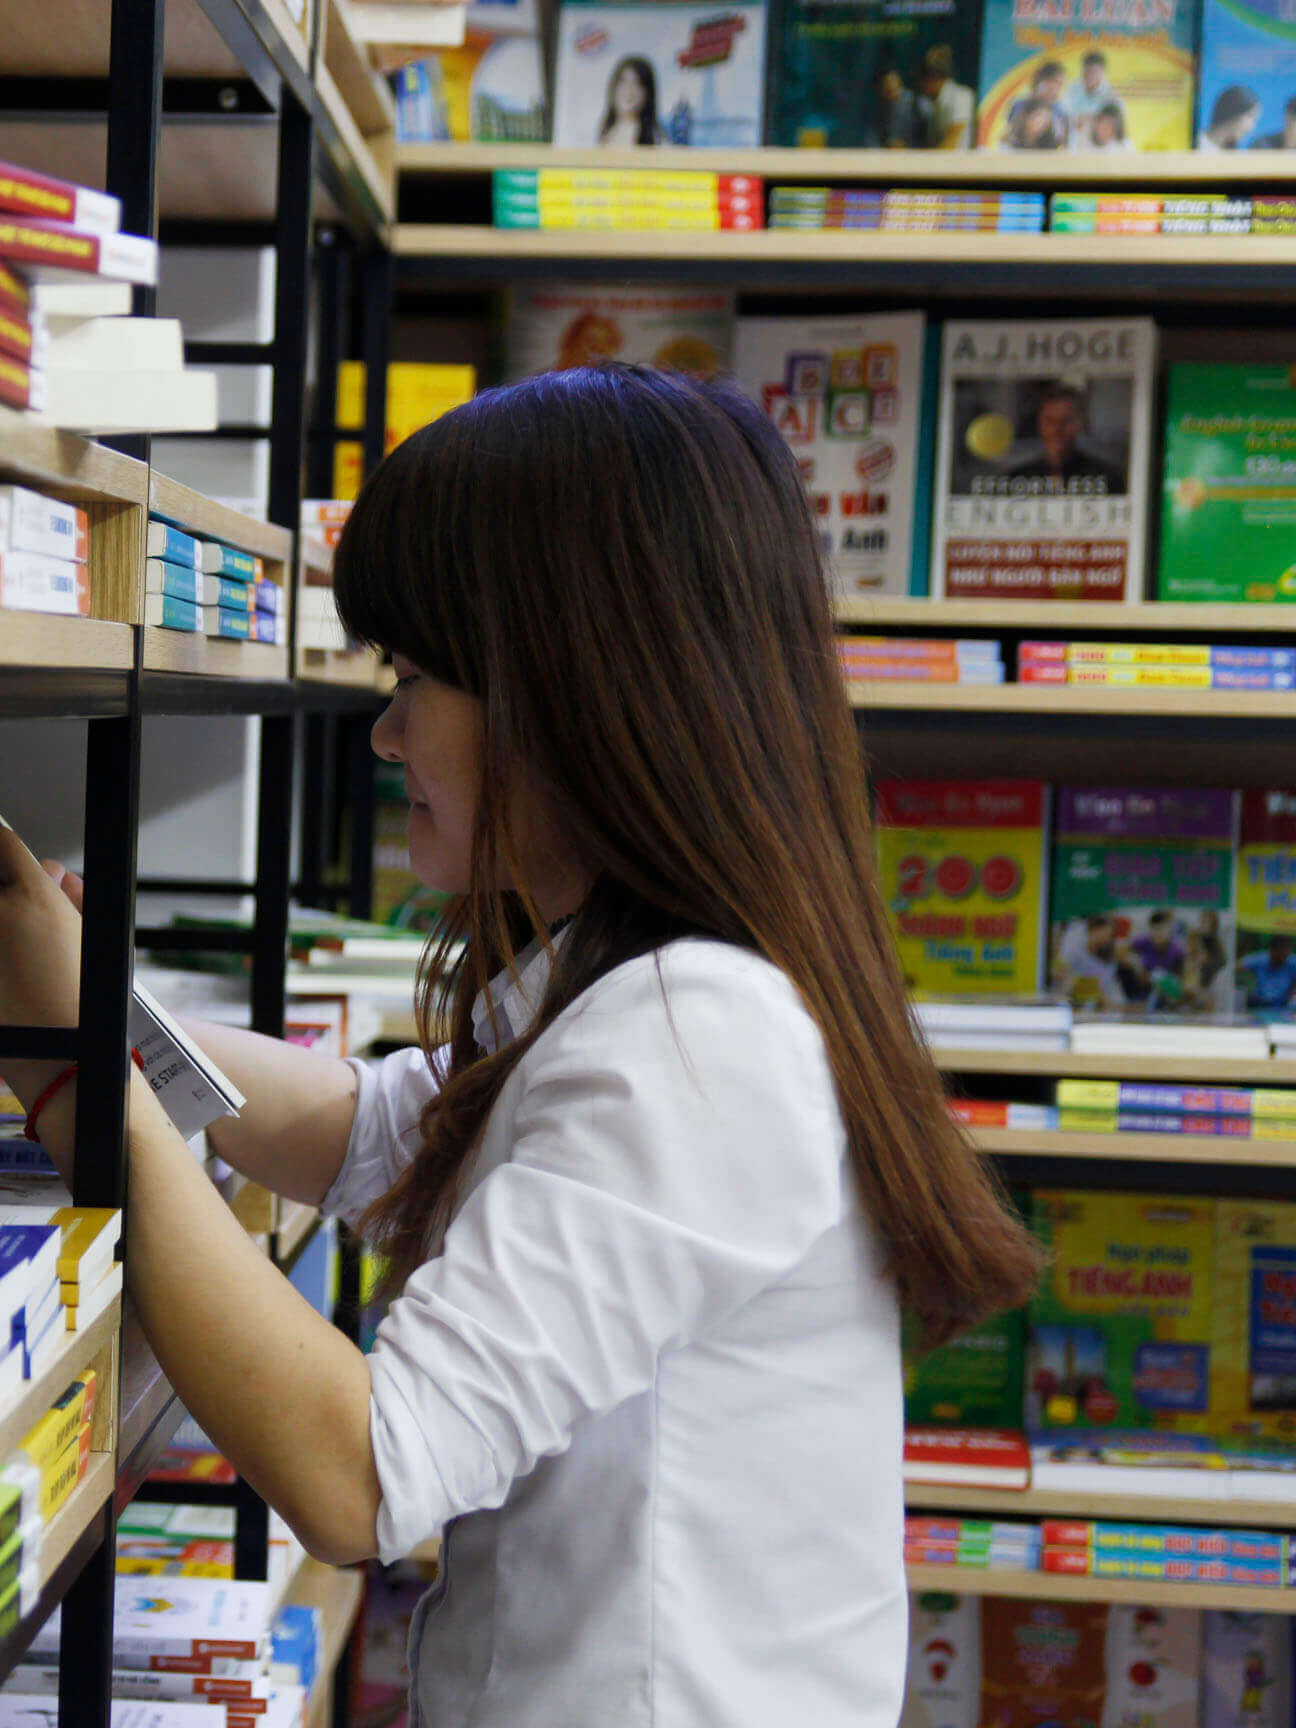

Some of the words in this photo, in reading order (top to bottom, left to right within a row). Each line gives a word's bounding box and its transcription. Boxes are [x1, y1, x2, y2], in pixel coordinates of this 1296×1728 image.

[1024, 328, 1136, 363] HOGE
[971, 475, 1108, 496] EFFORTLESS
[945, 500, 1132, 530] ENGLISH
[898, 853, 1023, 901] 200
